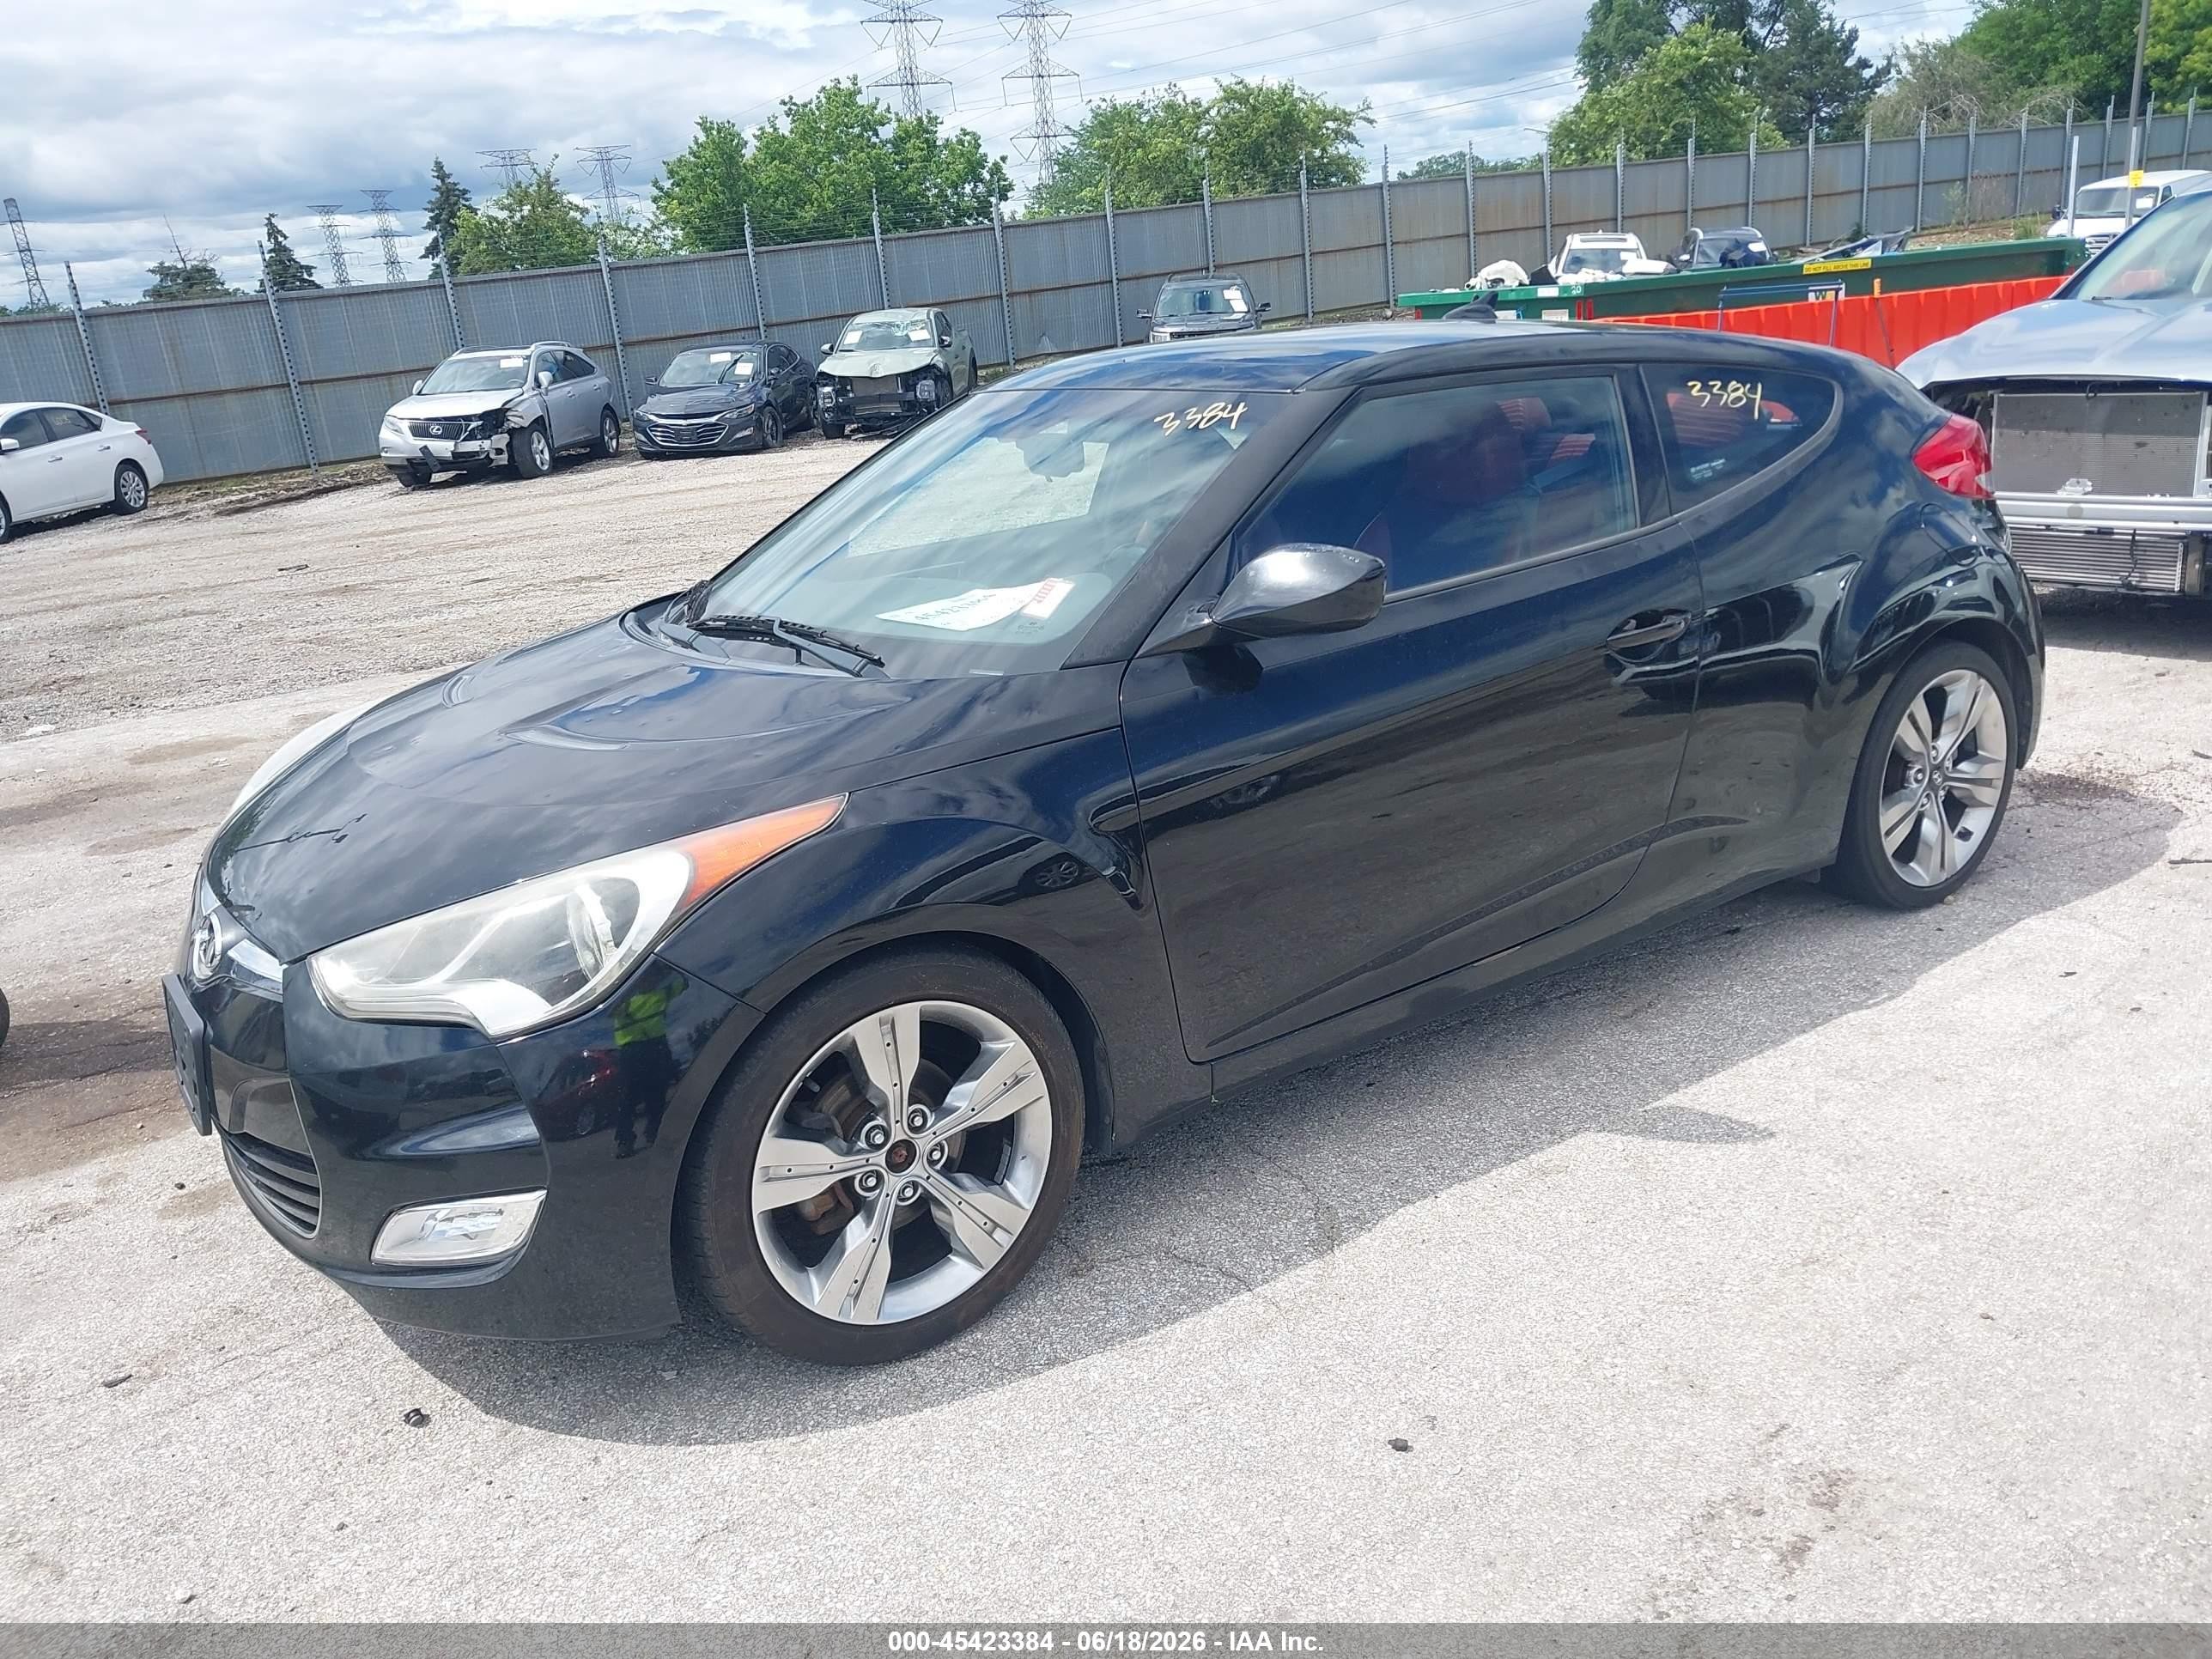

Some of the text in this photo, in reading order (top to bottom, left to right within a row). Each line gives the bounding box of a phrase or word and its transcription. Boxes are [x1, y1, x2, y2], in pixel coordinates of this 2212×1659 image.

[1571, 285, 1582, 295] 20
[1686, 380, 1762, 420] 3384
[1153, 402, 1248, 436] 3384
